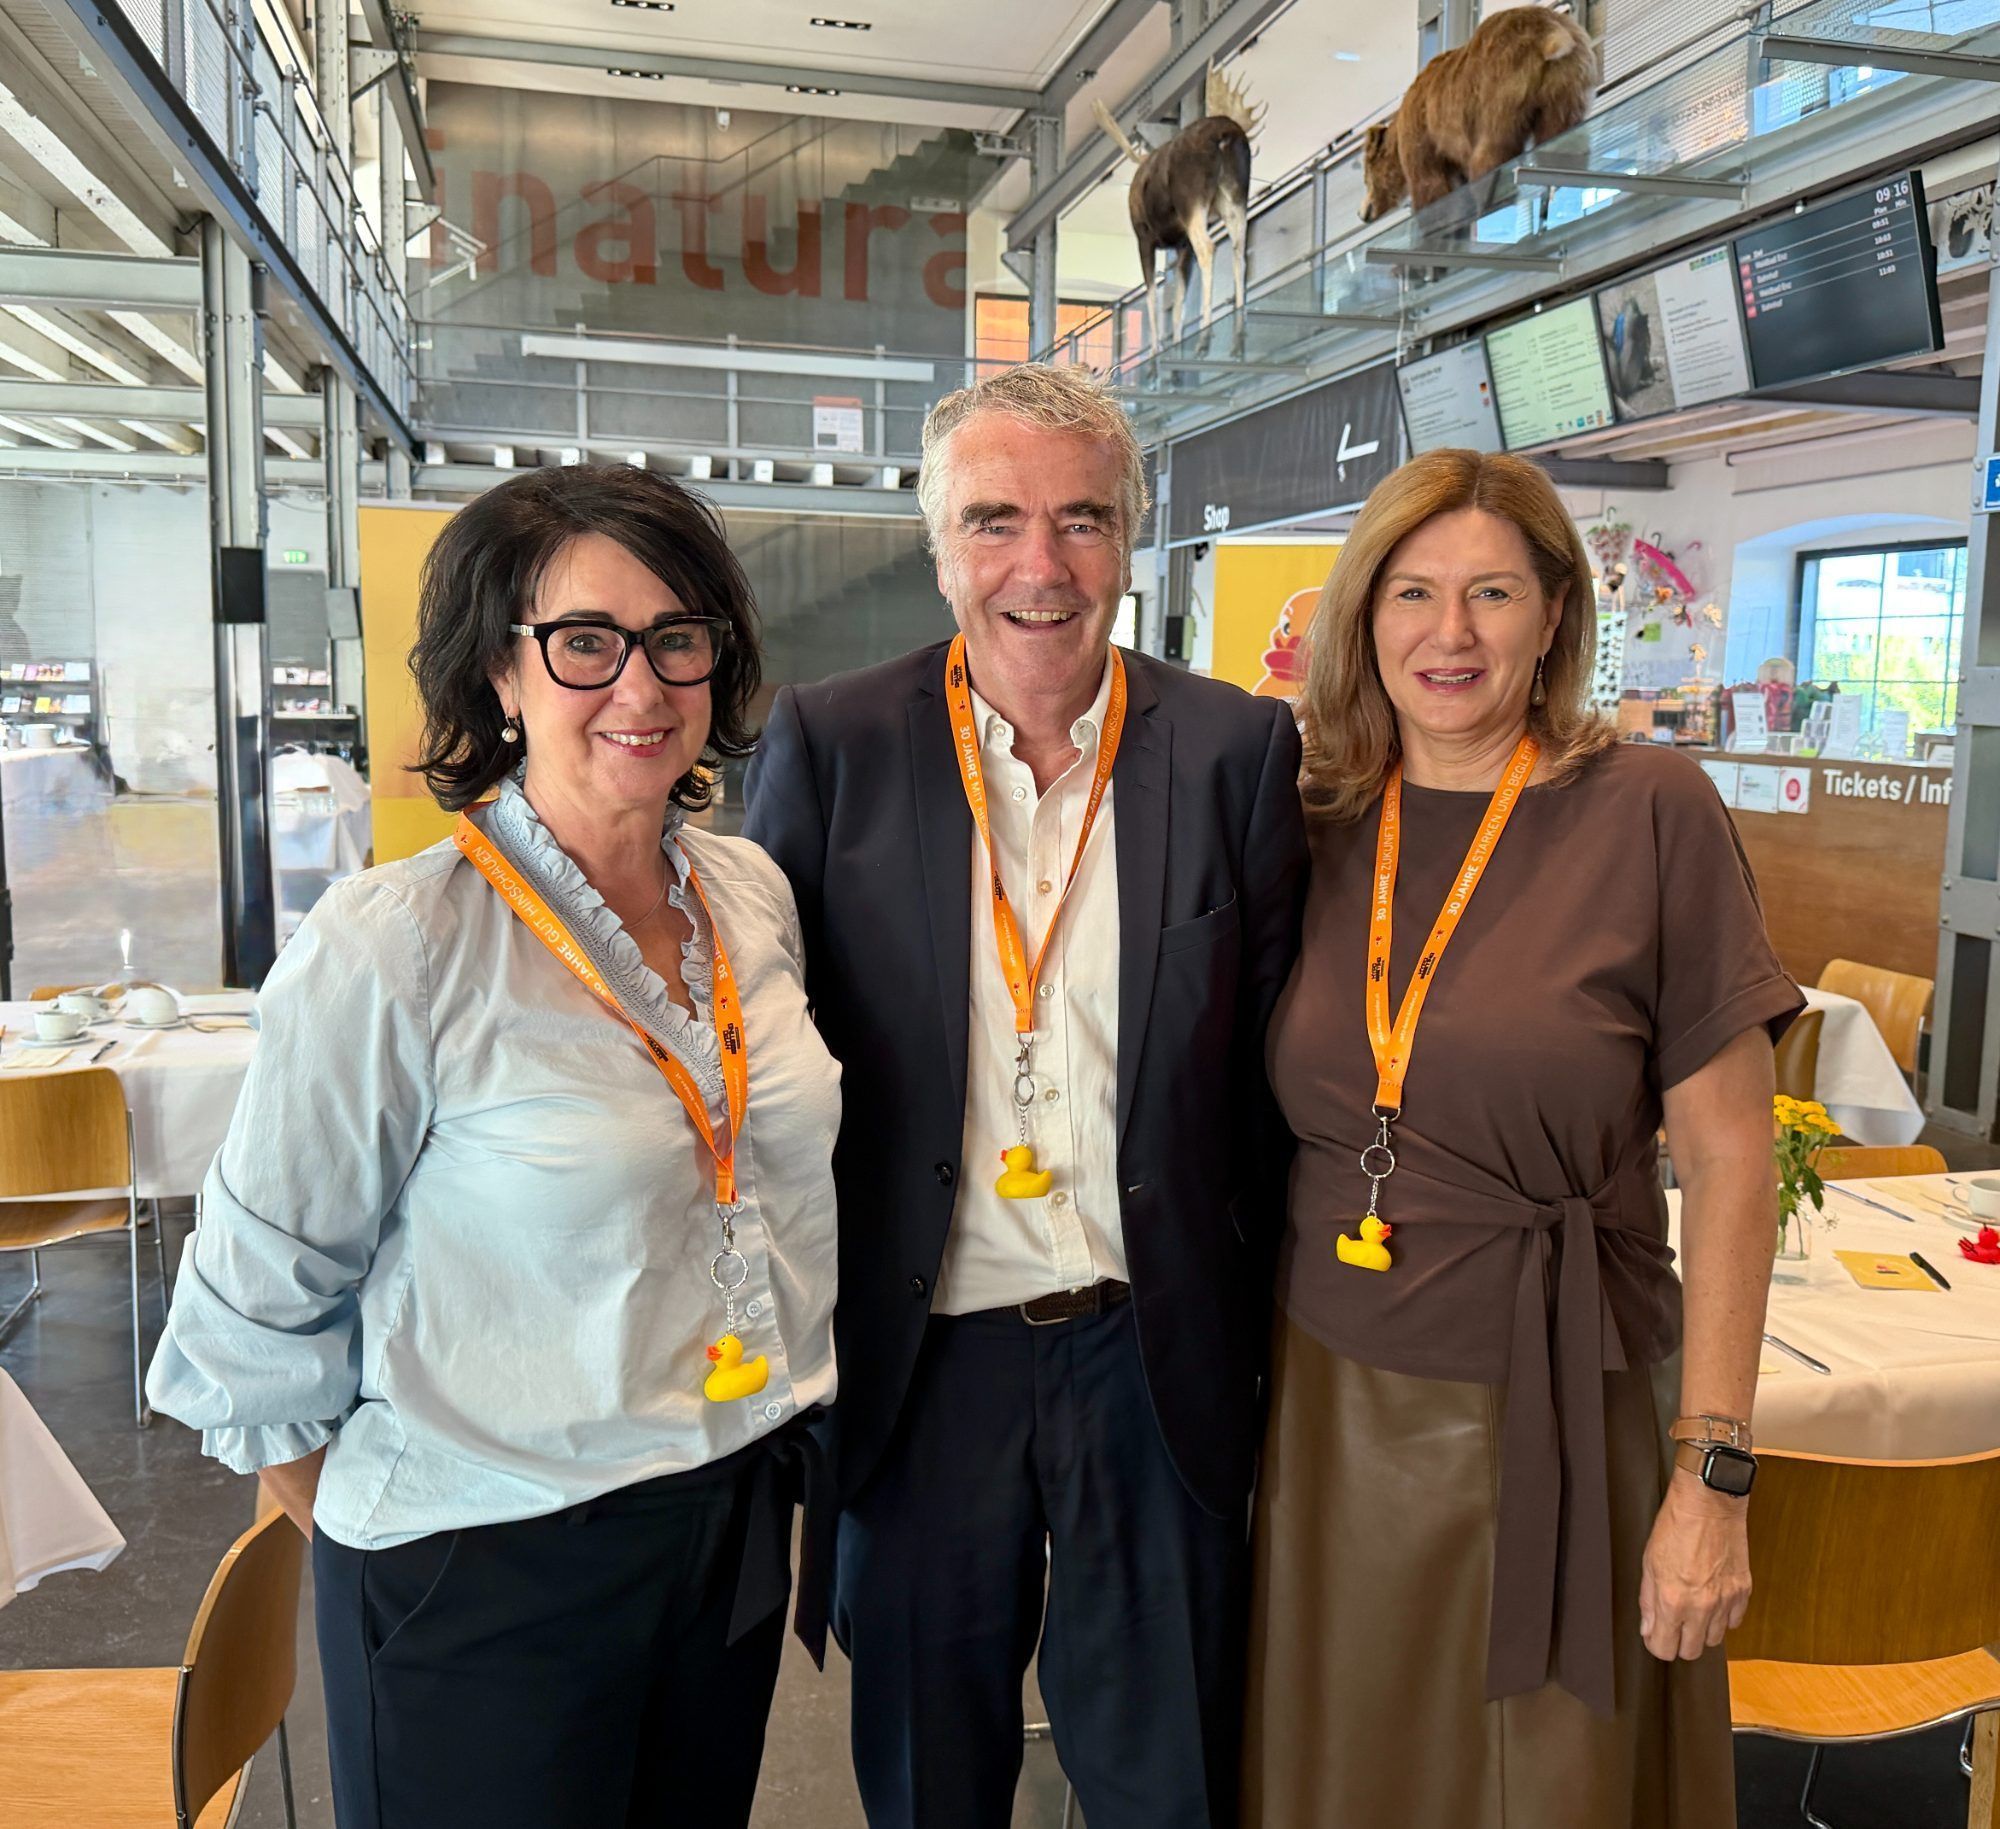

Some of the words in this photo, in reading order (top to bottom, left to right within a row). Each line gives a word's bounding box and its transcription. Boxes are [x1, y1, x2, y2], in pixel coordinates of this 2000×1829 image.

[1203, 503, 1231, 533] Shop
[960, 725, 971, 740] 30
[962, 743, 978, 780] JAHRE
[1822, 768, 1903, 801] Tickets
[1381, 826, 1395, 871] ZUKUNFT
[1447, 901, 1461, 917] 30
[1455, 864, 1480, 901] JAHRE
[1497, 787, 1516, 814] UND
[471, 845, 539, 918] HINSCHAUEN
[1377, 873, 1391, 905] JAHRE
[533, 917, 560, 944] GUT
[1376, 907, 1387, 922] 30
[556, 941, 595, 980] JAHRE
[718, 963, 729, 981] 30
